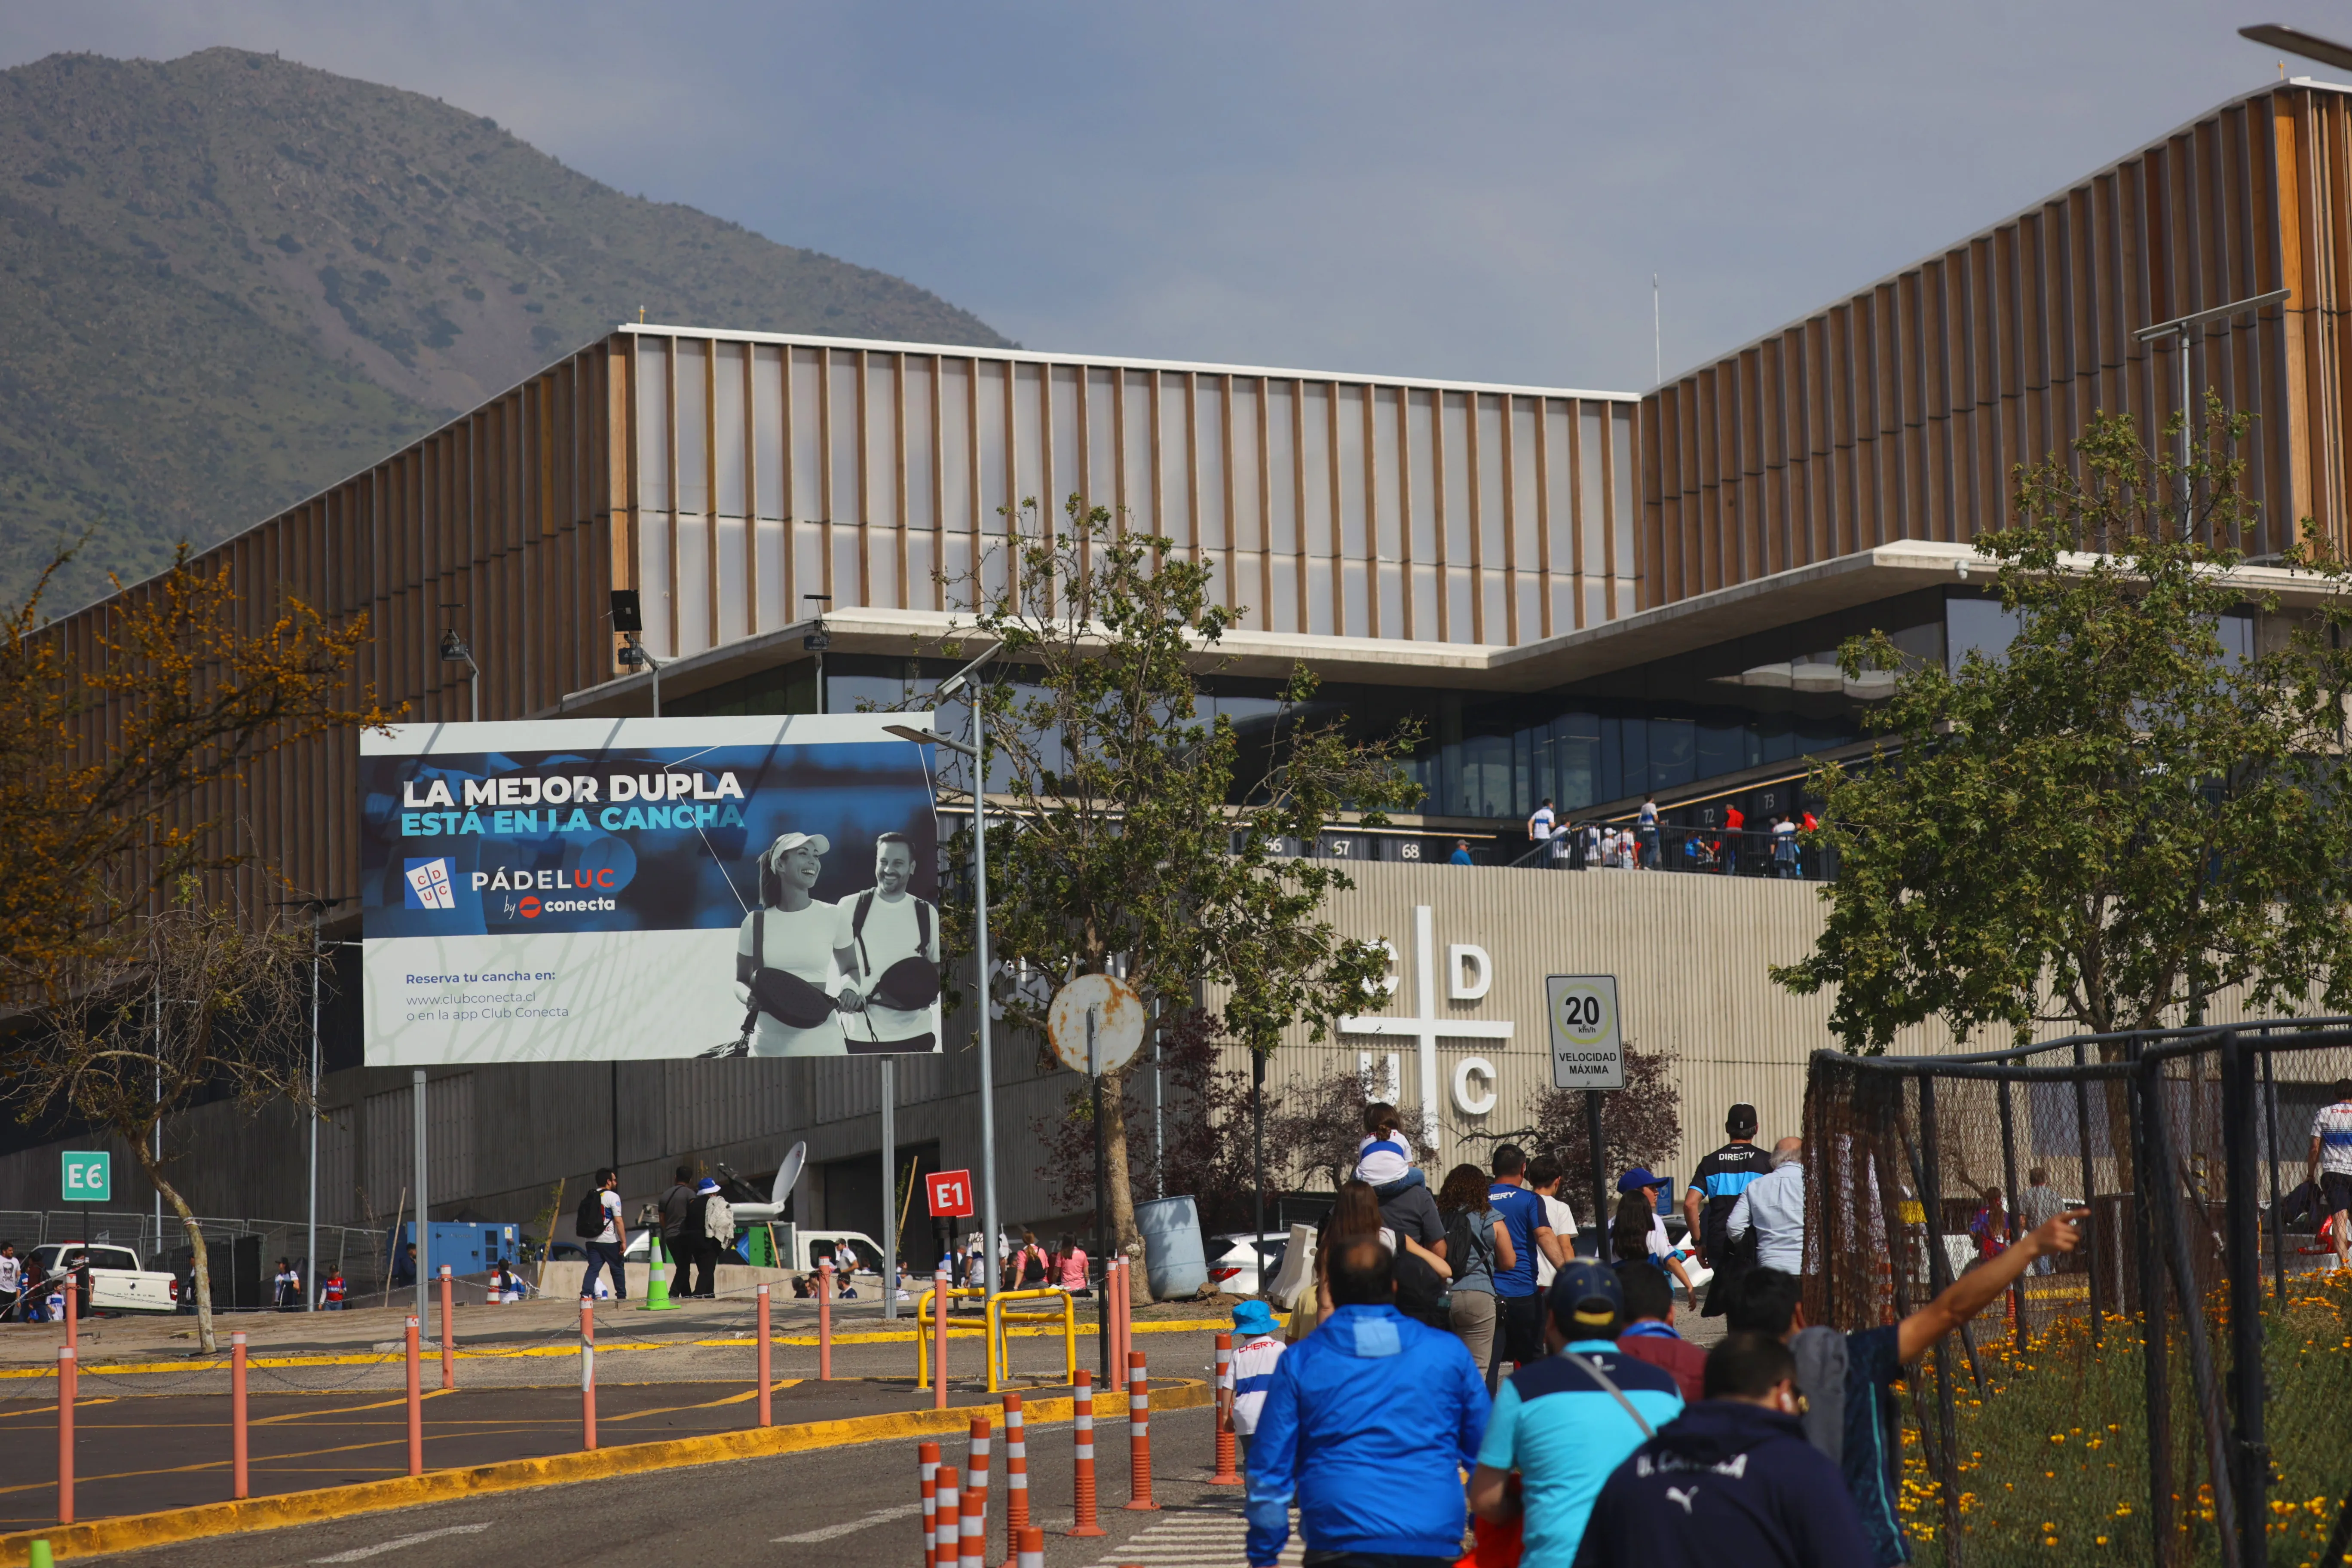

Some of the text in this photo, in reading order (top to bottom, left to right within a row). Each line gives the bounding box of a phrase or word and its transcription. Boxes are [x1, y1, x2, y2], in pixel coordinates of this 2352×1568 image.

[404, 772, 744, 807] LA MEJOR DUPLA
[1764, 793, 1774, 810] 73
[402, 804, 744, 836] ESTÁ EN LA CANCHA
[1704, 808, 1715, 824] 72
[1265, 838, 1283, 852] 66
[1333, 840, 1350, 855] 67
[1402, 844, 1419, 859] 68
[472, 867, 614, 891] PÁDELUC
[504, 895, 615, 919] by conecta
[406, 971, 556, 984] Reserva tu cancha en:
[407, 991, 536, 1005] www.clubconecta.cl
[418, 1012, 434, 1020] en
[439, 1010, 449, 1020] la
[453, 1010, 478, 1021] app
[482, 1008, 511, 1019] Club
[516, 1007, 569, 1018] Conecta
[1565, 996, 1599, 1025] 20
[1559, 1052, 1617, 1062] VELOCIDAD
[1569, 1064, 1609, 1074] MÁXIMA
[1719, 1152, 1755, 1161] DIRECTV
[68, 1164, 103, 1188] E6
[937, 1182, 964, 1208] E1
[1488, 1191, 1517, 1200] HERY
[1238, 1341, 1277, 1353] CHERY
